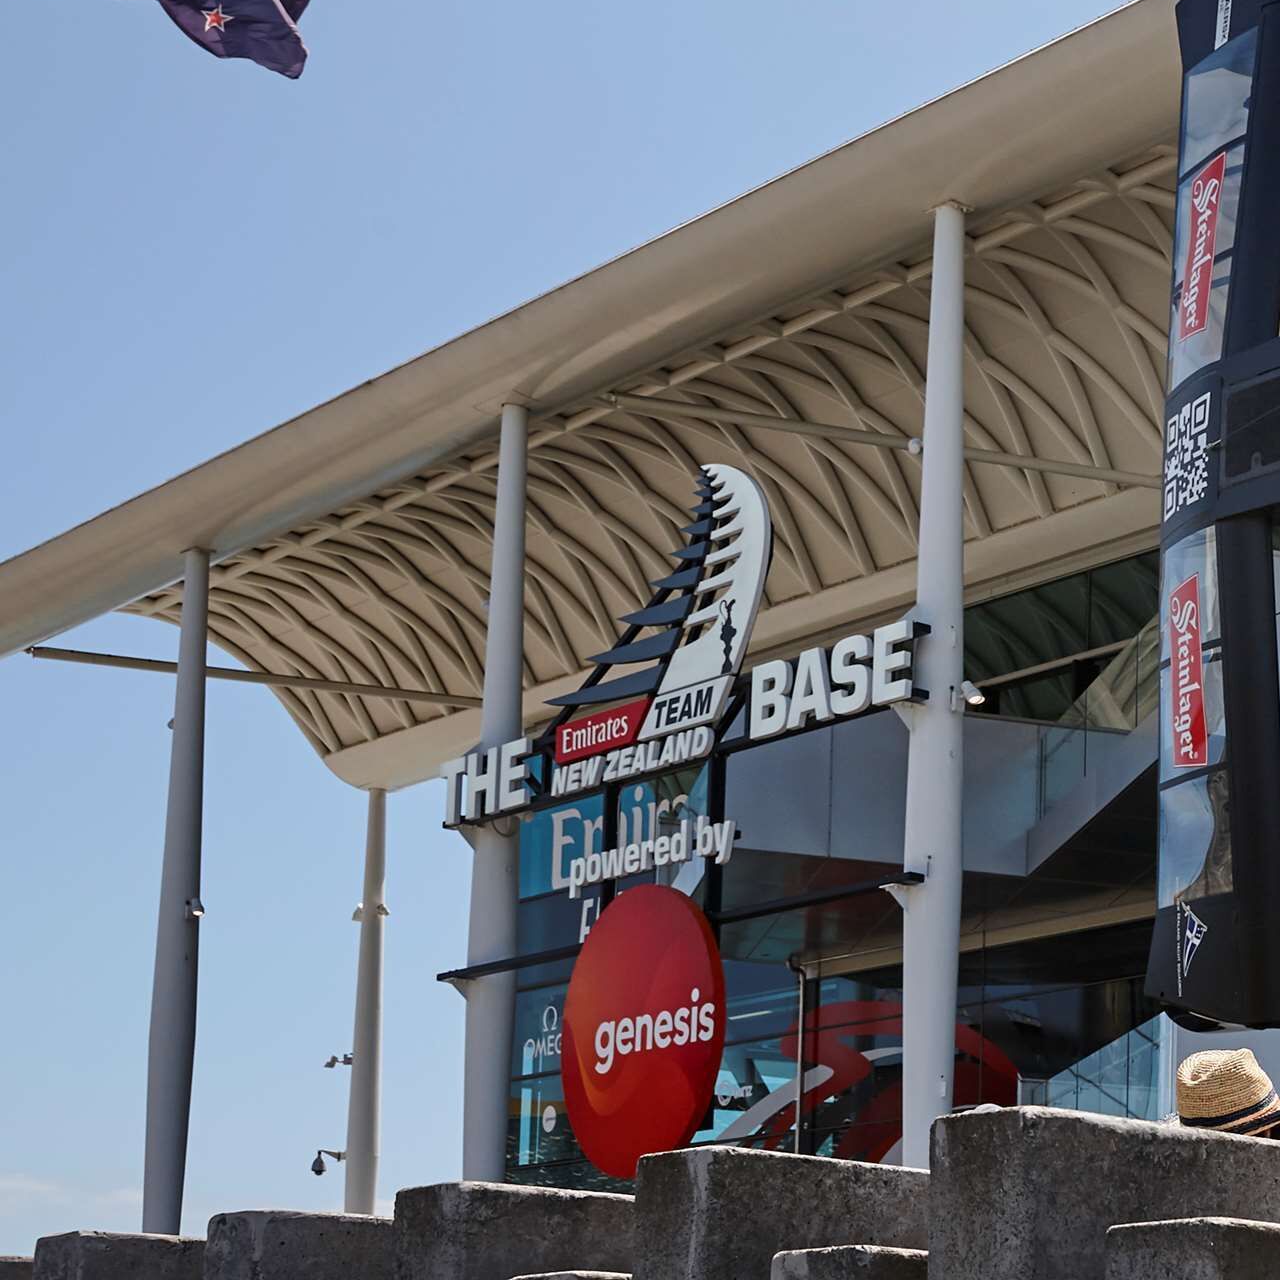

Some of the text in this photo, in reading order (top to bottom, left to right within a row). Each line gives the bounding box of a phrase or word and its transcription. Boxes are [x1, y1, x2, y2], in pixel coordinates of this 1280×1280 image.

[1180, 177, 1218, 329] Steinlager
[655, 686, 714, 729] TEAM
[750, 619, 914, 740] BASE
[1170, 596, 1201, 760] Steinlager
[551, 725, 714, 797] NEW ZEALAND
[561, 714, 629, 754] Emirates
[441, 736, 532, 824] THE
[569, 814, 736, 899] powered by
[523, 1032, 562, 1058] OMEG
[594, 987, 716, 1075] genesis
